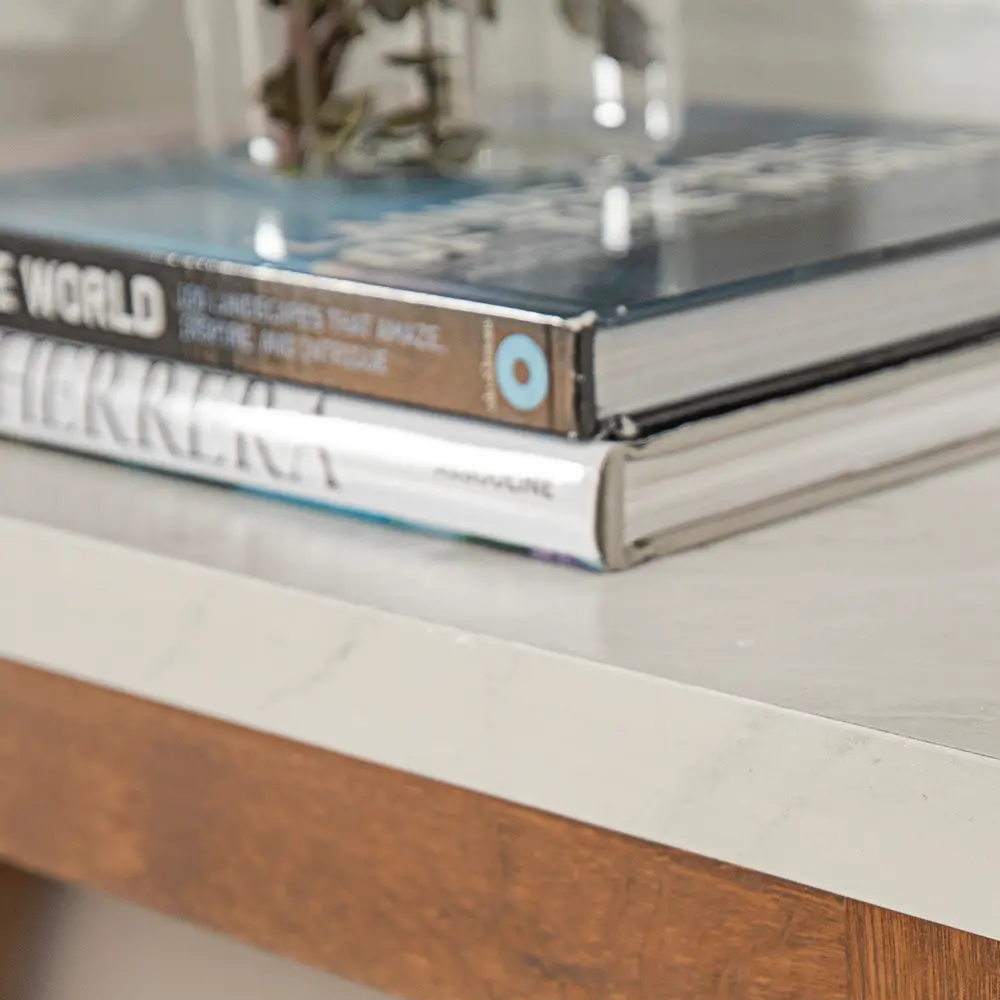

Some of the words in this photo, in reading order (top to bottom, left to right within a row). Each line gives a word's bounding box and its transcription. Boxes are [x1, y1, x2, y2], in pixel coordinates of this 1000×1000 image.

[19, 255, 165, 339] WORLD
[326, 307, 374, 336] THAT
[258, 328, 296, 357] AND
